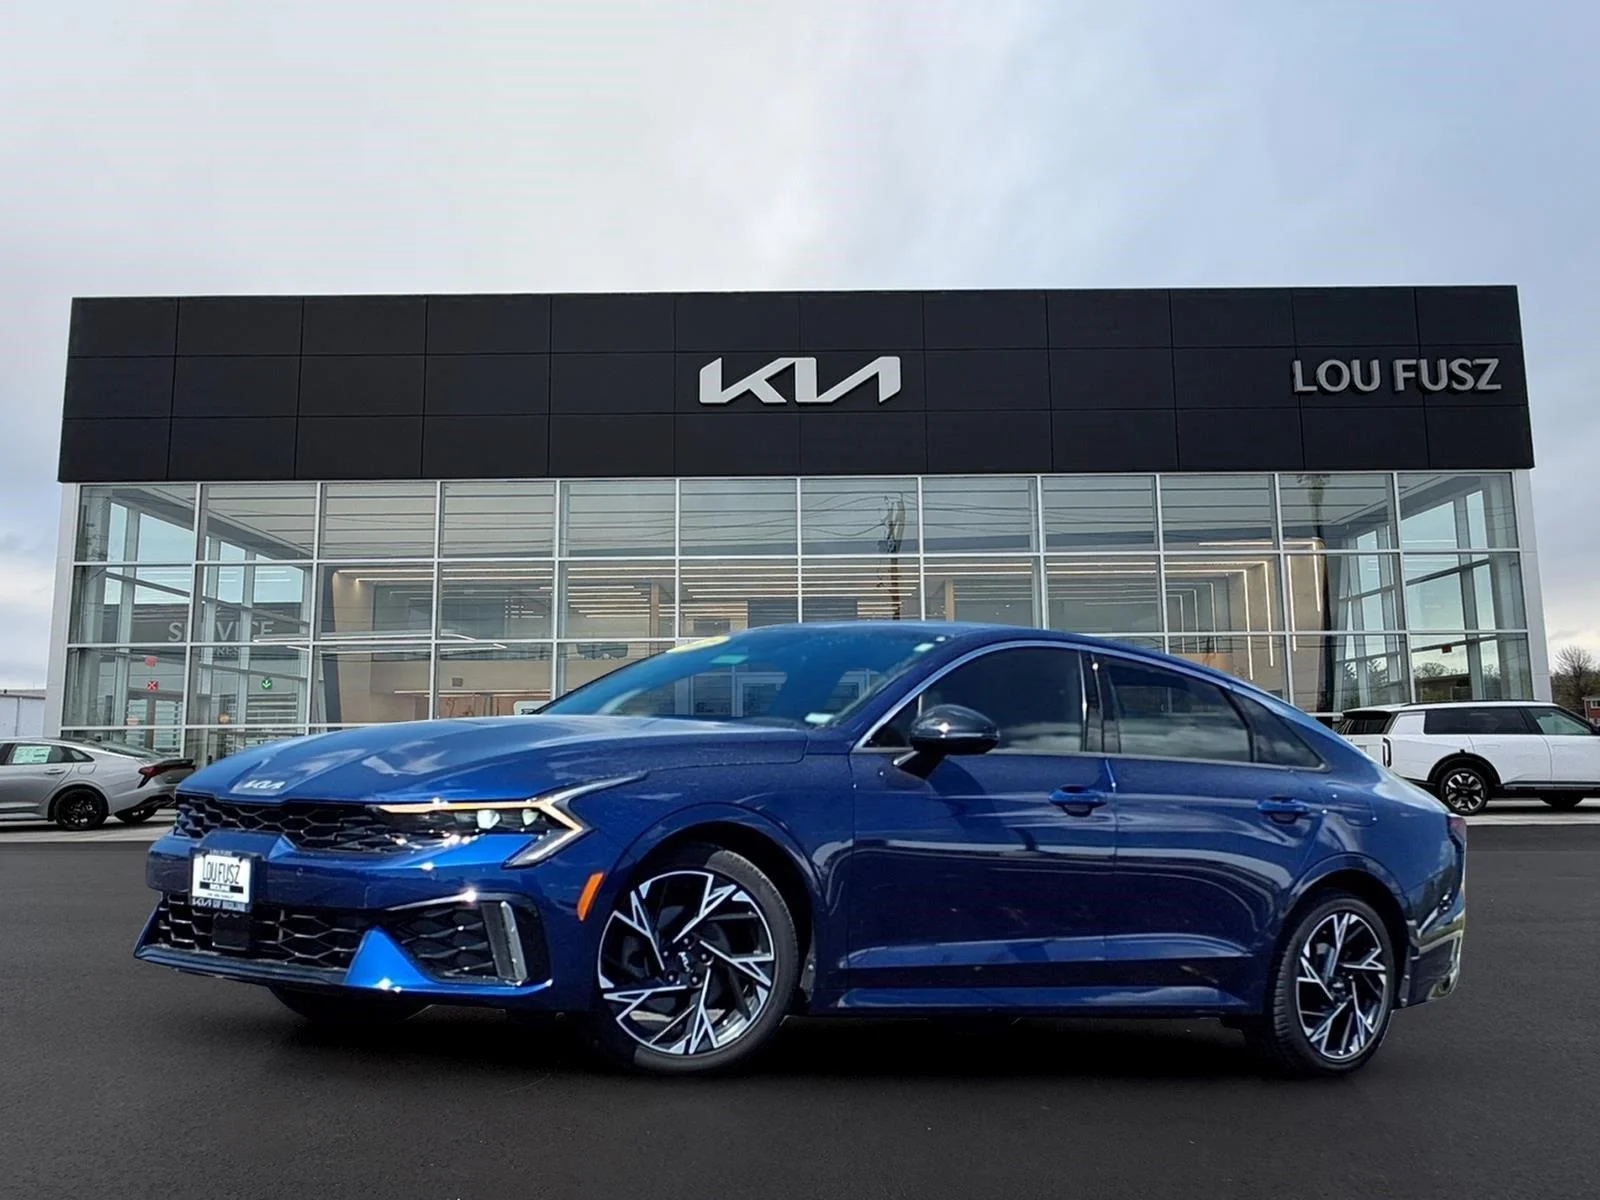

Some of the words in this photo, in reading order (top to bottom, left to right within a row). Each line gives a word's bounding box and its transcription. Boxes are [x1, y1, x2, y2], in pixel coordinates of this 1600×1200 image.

[699, 356, 902, 404] KIA
[1292, 358, 1382, 393] LOU
[1392, 357, 1503, 392] FUSZ
[203, 861, 217, 881] LOU
[218, 863, 240, 884] FUSZ
